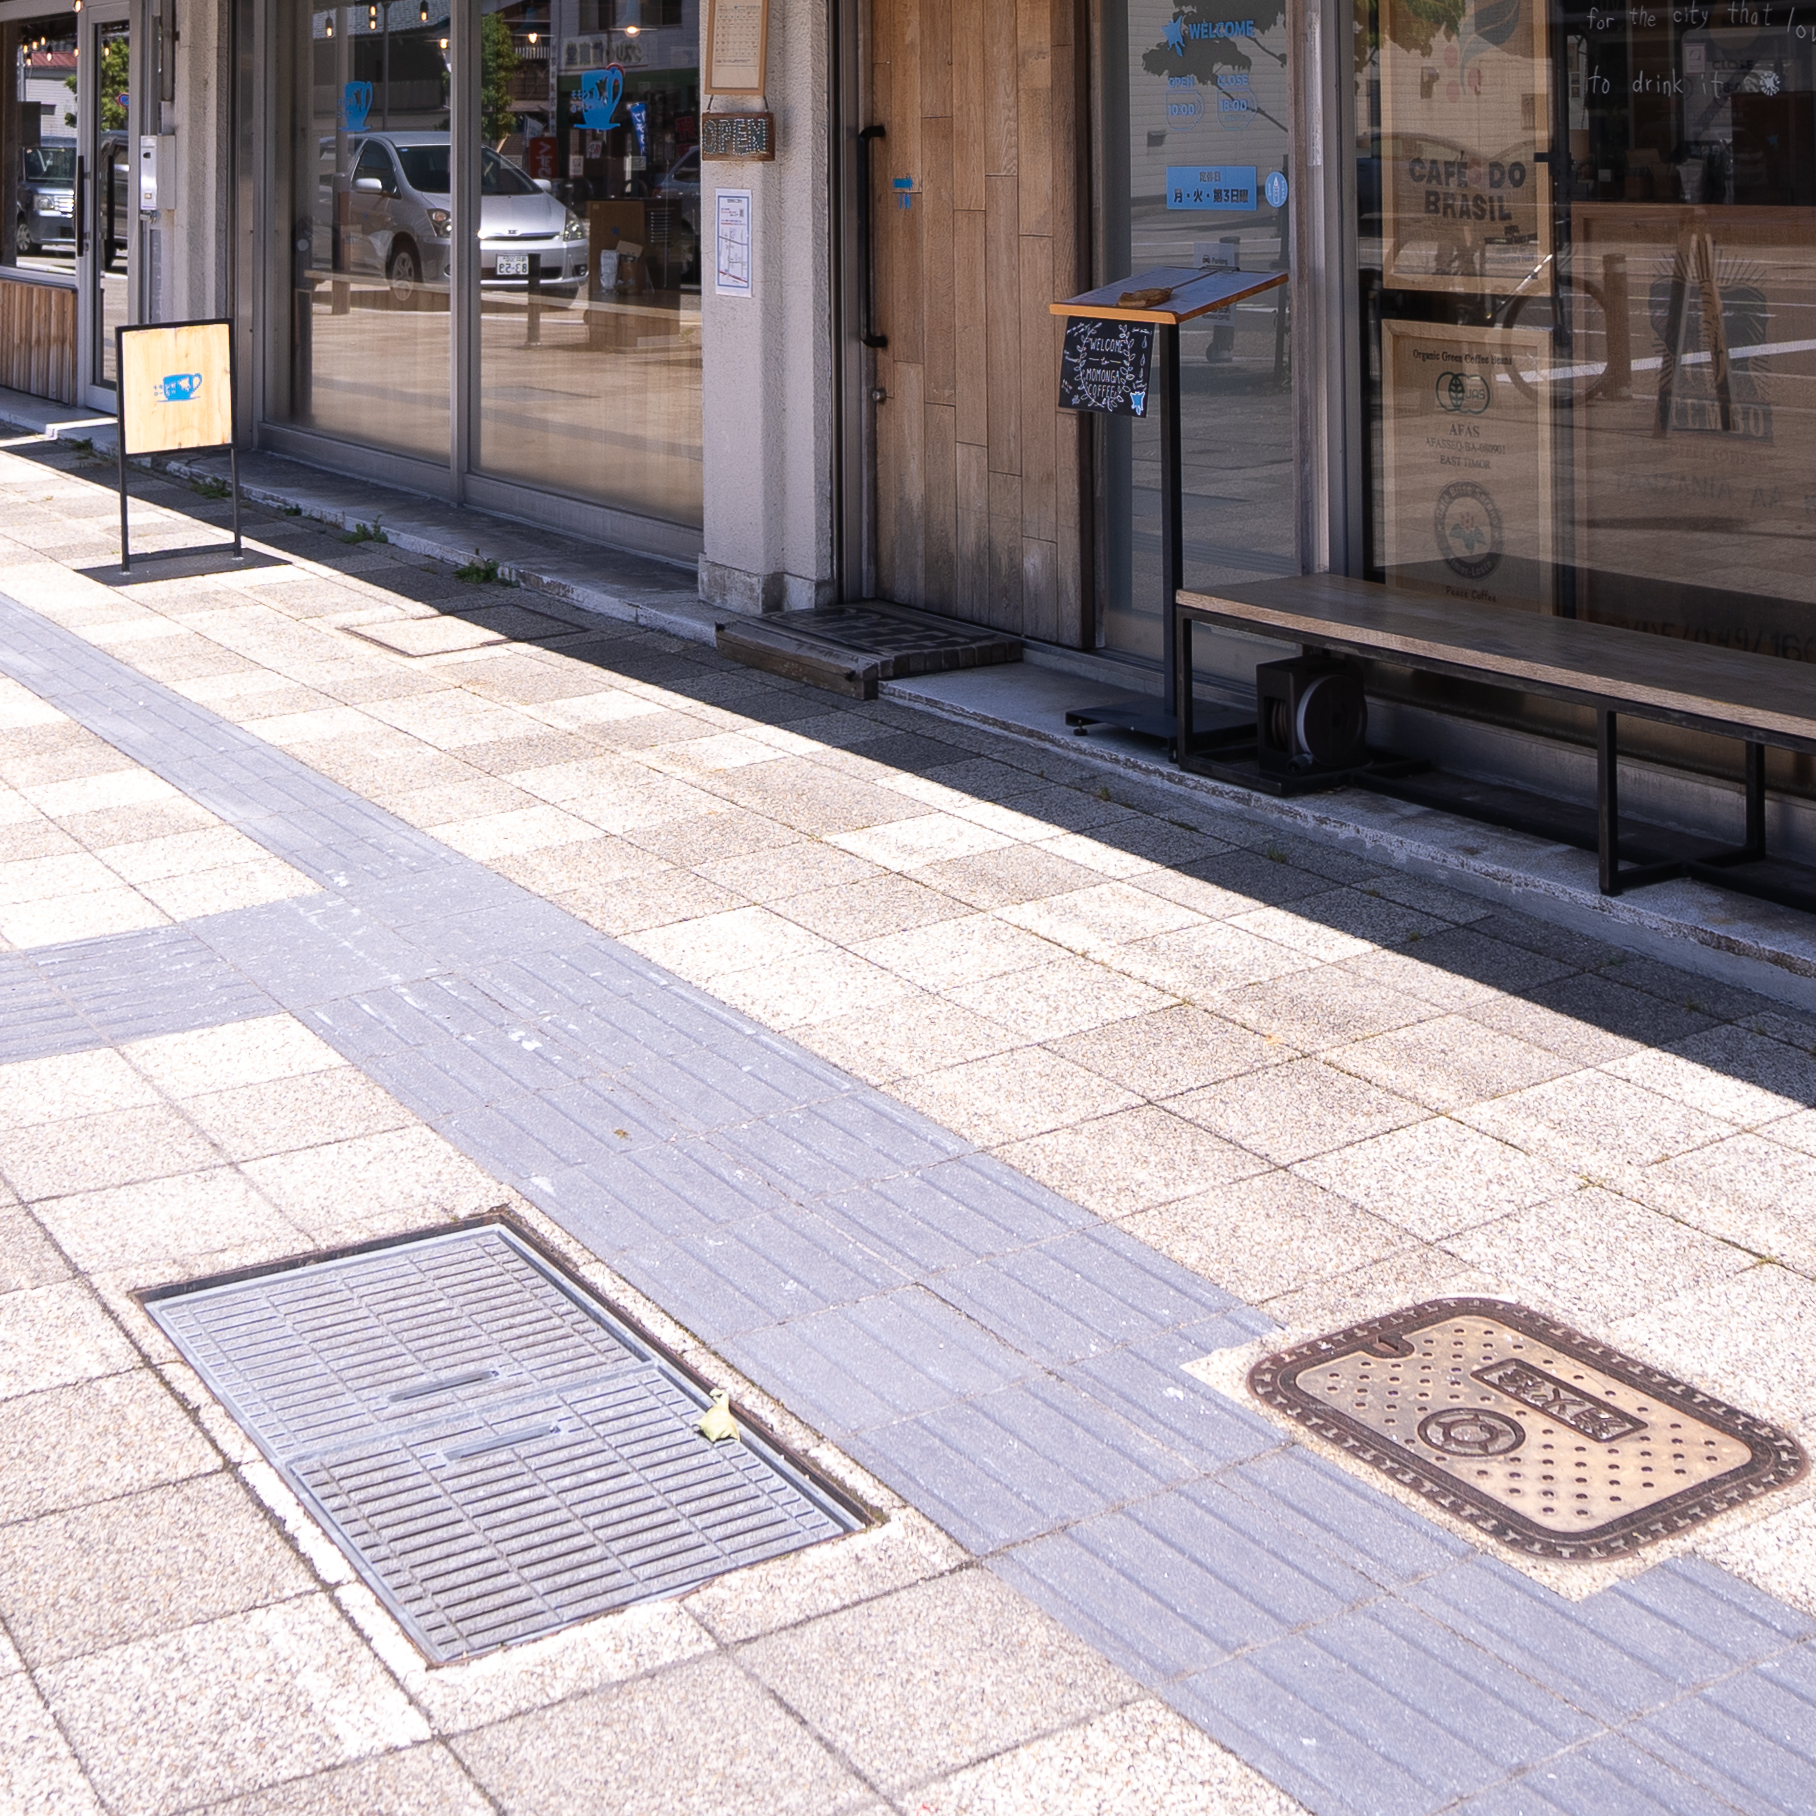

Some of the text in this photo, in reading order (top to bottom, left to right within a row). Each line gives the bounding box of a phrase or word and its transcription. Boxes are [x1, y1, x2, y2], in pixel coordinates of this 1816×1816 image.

[1188, 19, 1255, 40] WELCOME
[1587, 7, 1615, 30] for
[1629, 5, 1657, 28] the
[1673, 0, 1709, 31] city
[1727, 0, 1773, 26] that
[1168, 73, 1248, 88] OPEN CLOSE
[1588, 65, 1722, 98] to drink it
[702, 118, 768, 155] OPEN
[1408, 150, 1527, 189] CAFÉ DO
[1424, 189, 1513, 222] BRASIL
[1412, 348, 1440, 363] Organic
[1441, 351, 1463, 363] Green
[1464, 353, 1489, 364] Coffee
[1440, 455, 1461, 467] EAST
